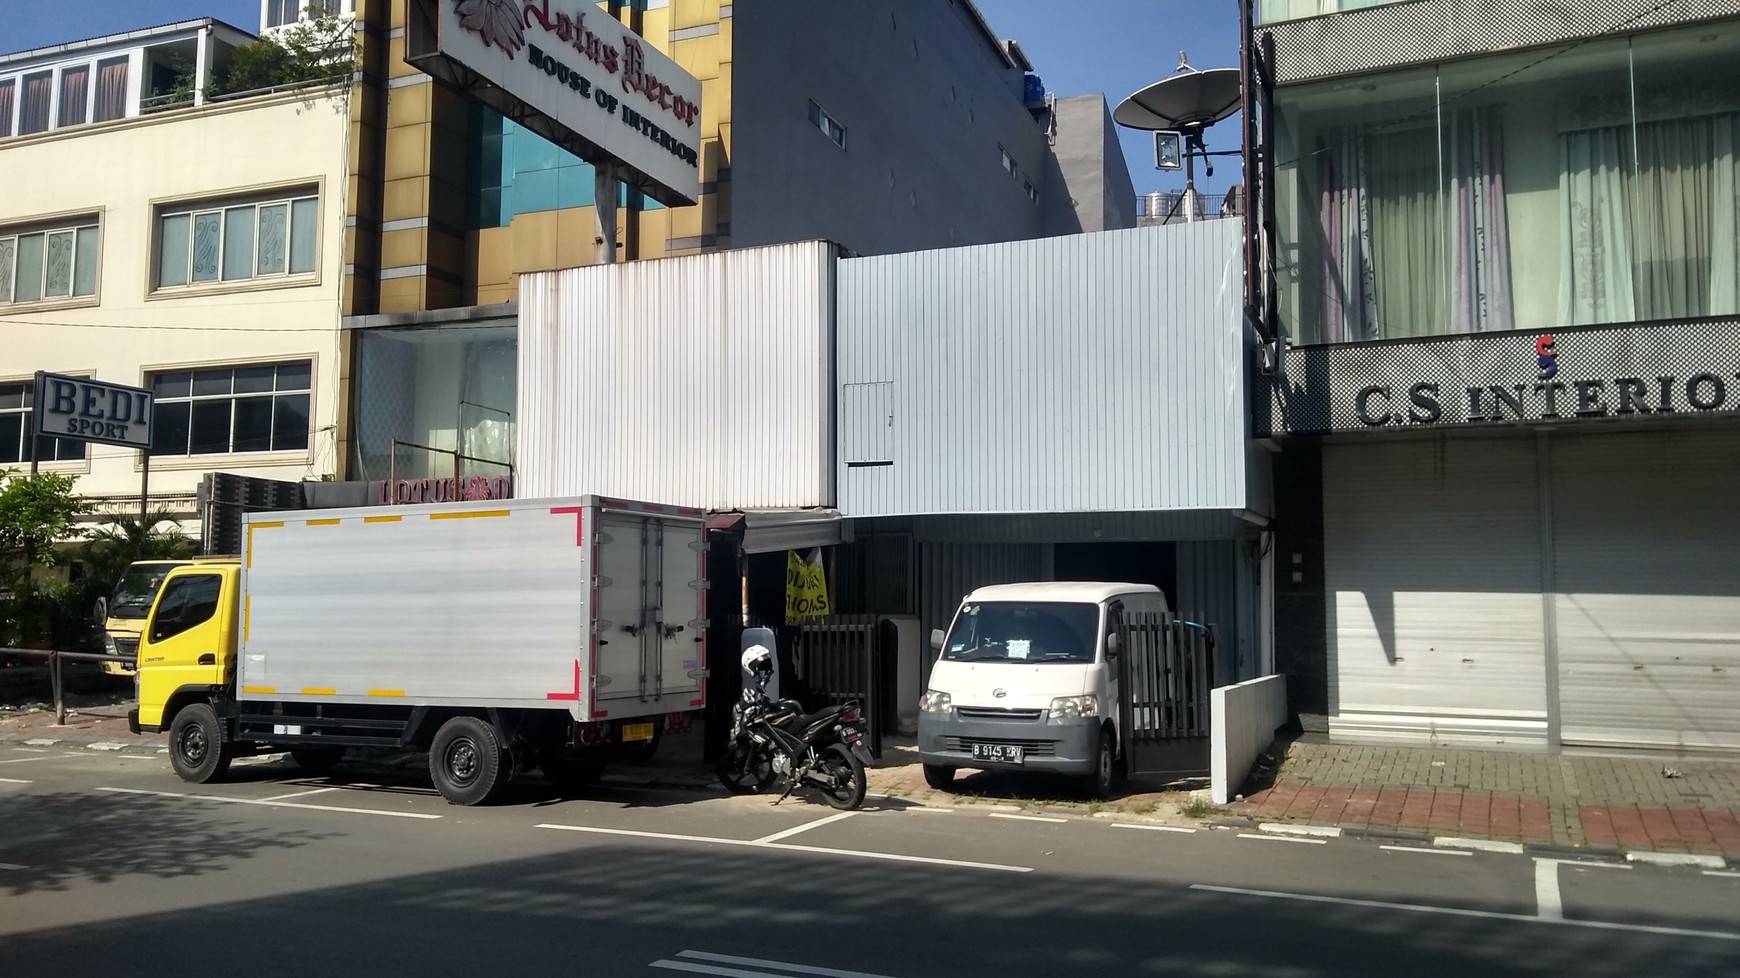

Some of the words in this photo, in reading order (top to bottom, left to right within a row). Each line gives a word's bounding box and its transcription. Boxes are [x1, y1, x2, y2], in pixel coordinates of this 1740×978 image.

[528, 43, 591, 99] HOUSE
[594, 88, 619, 115] OF
[621, 104, 698, 168] INTERIOR
[622, 36, 700, 128] Decor
[49, 379, 148, 426] BEDI
[1355, 381, 1441, 426] C.S
[1466, 372, 1740, 419] INTERIO
[67, 417, 129, 440] SPORT
[974, 744, 980, 755] B
